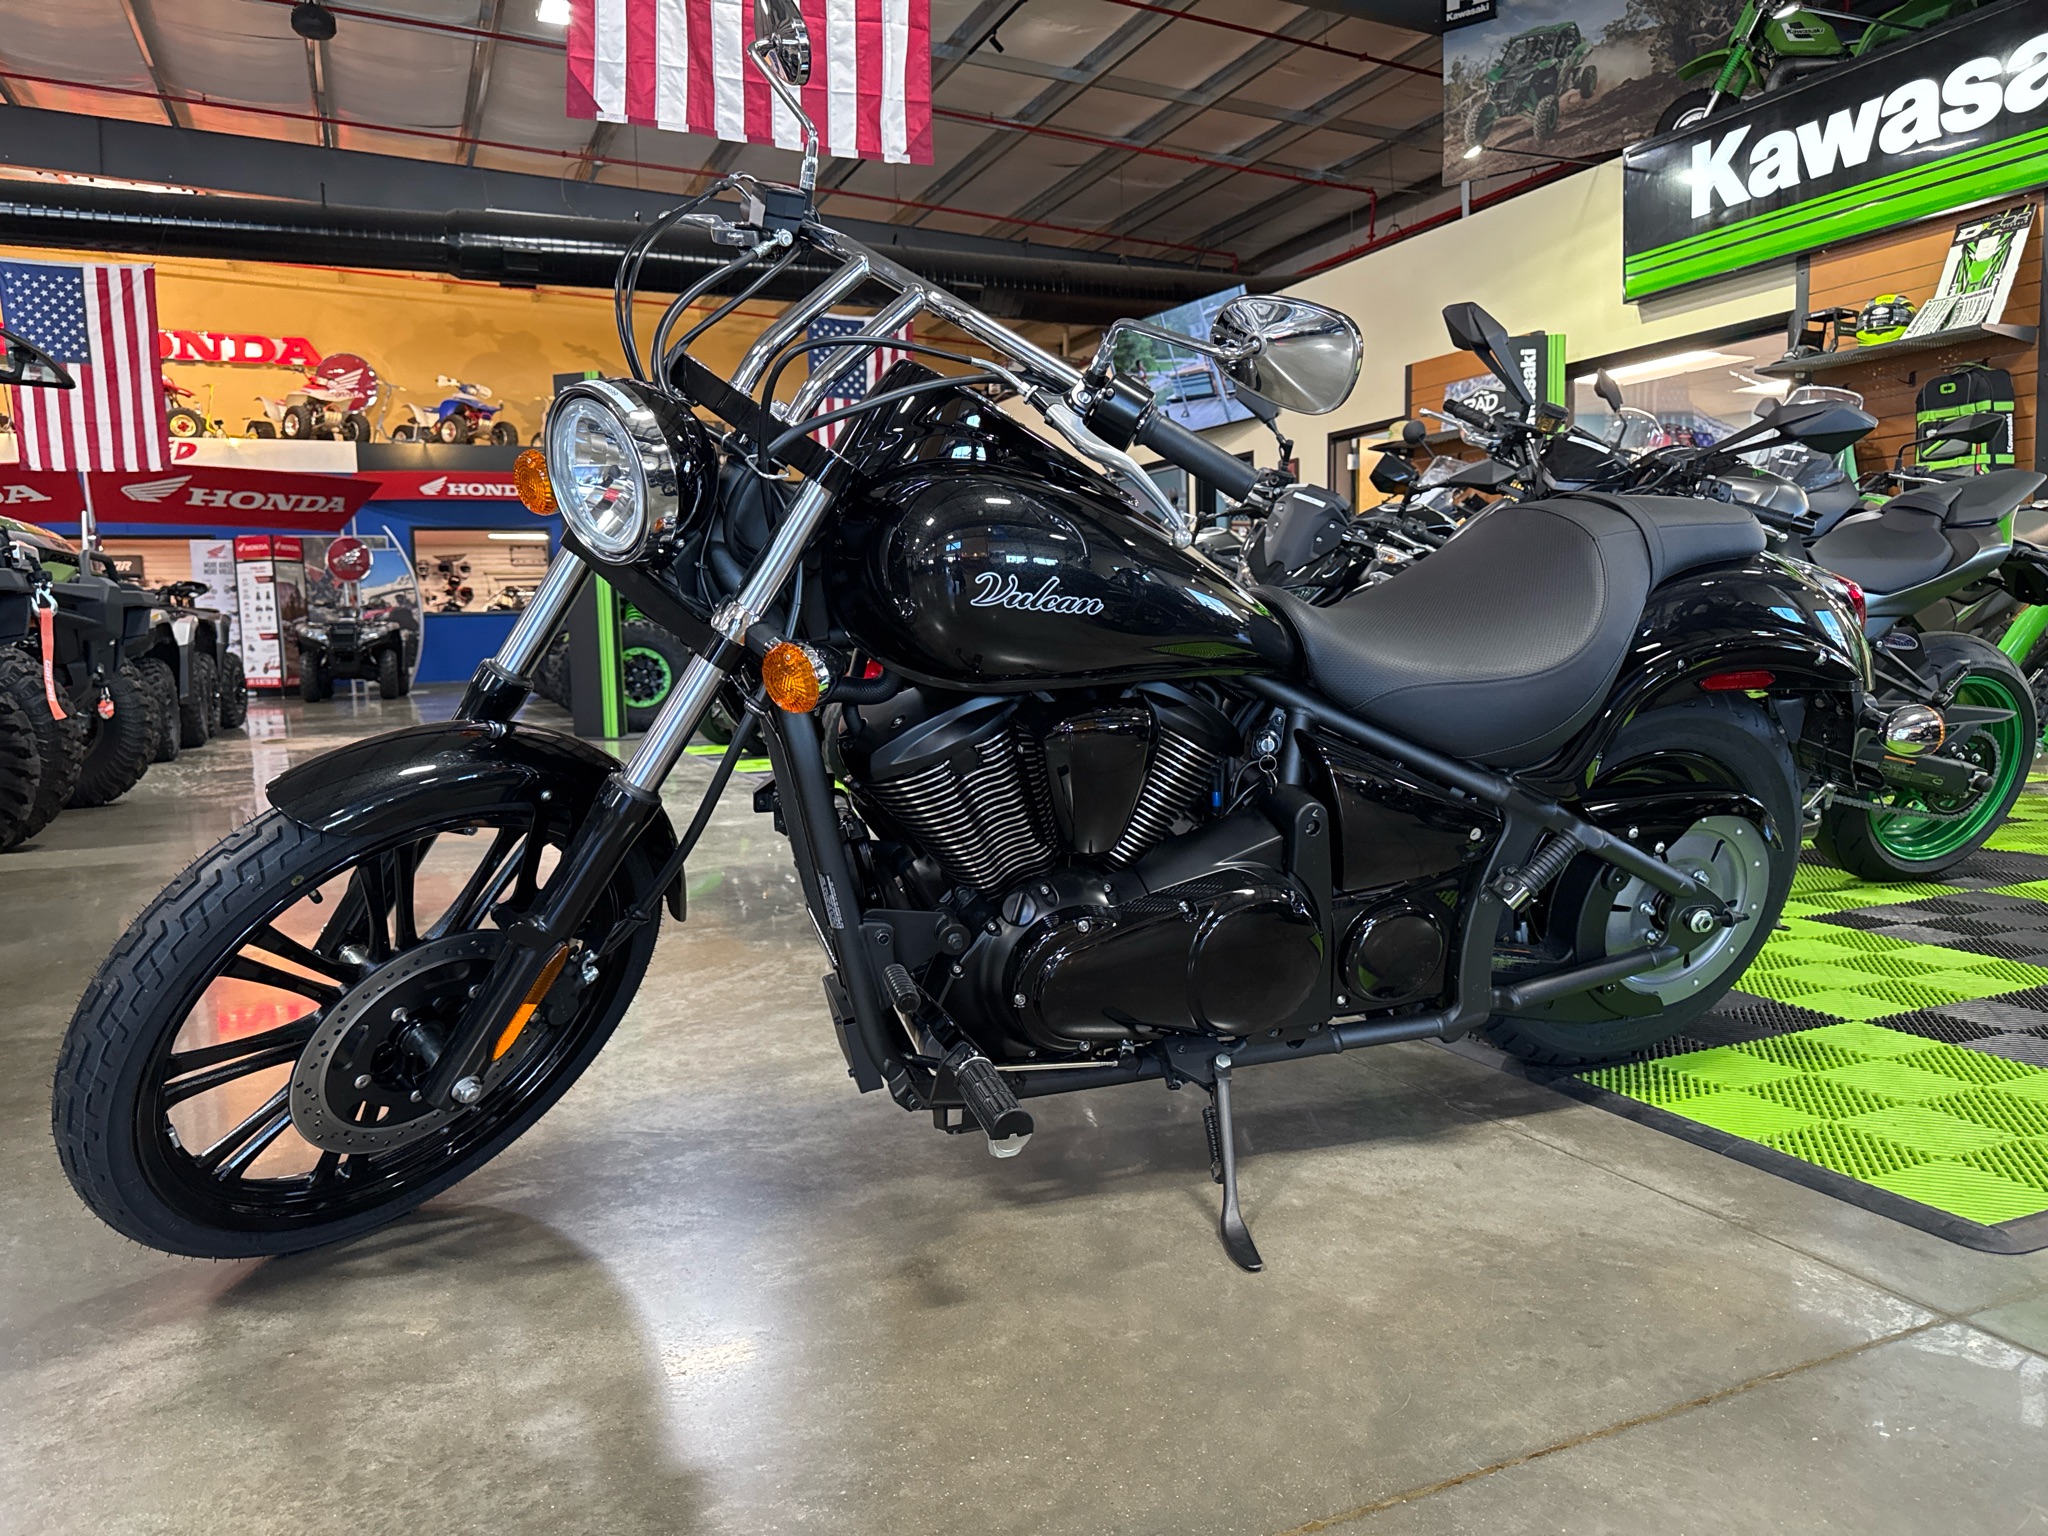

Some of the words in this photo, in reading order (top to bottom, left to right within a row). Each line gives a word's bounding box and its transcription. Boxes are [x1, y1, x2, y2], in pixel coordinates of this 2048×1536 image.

[1446, 4, 1490, 22] Kawasaki
[1786, 27, 1825, 35] Kawasaki
[1691, 33, 2048, 220] Kawasa
[2006, 413, 2014, 453] Kawasaki
[185, 487, 345, 513] HONDA
[245, 543, 269, 551] HONDA
[970, 572, 1104, 615] Vulcan
